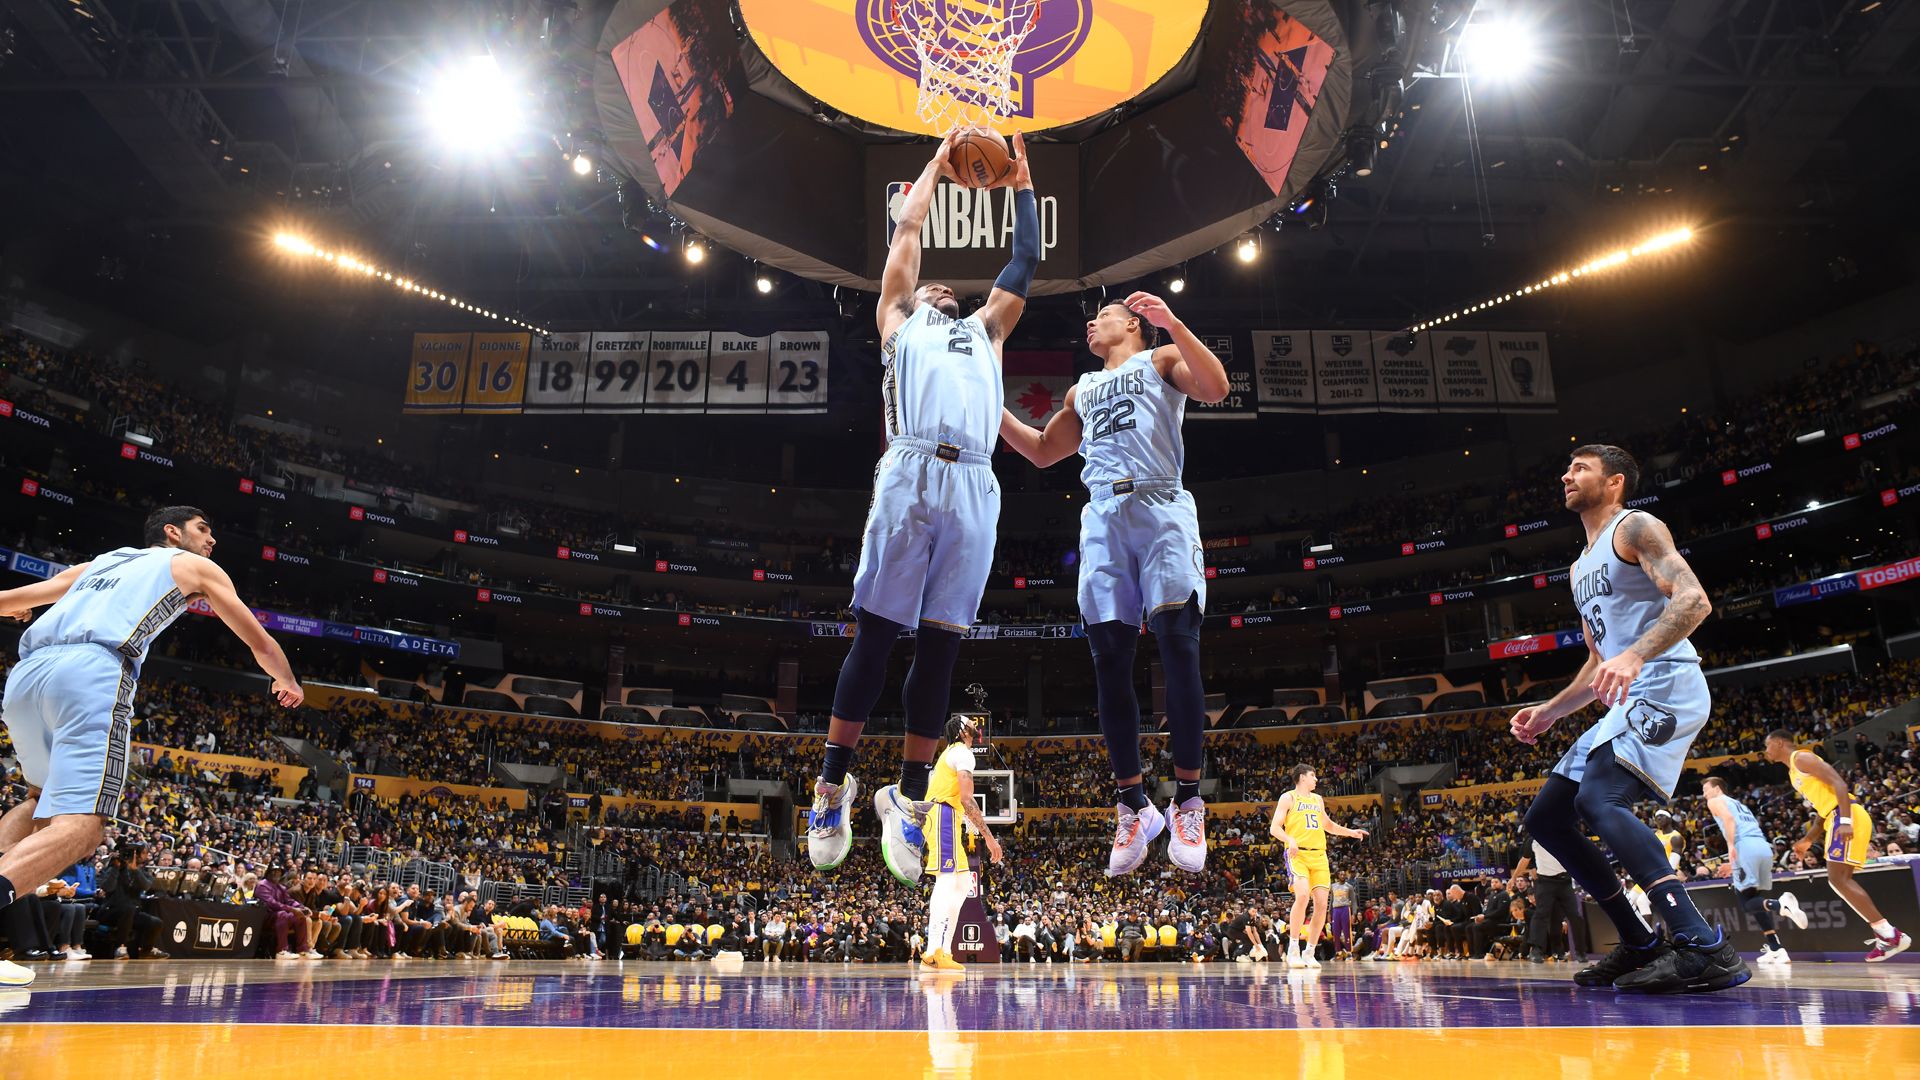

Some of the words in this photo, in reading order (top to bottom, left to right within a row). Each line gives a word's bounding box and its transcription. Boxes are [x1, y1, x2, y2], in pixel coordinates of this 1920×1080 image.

[922, 183, 996, 249] NBA
[1000, 186, 1058, 261] Ap
[421, 341, 463, 351] VACHON
[479, 341, 521, 351] DIONNE
[541, 341, 580, 351] TAYLOR
[596, 341, 645, 351] GRETZKY
[652, 340, 708, 350] ROBITAILLE
[722, 341, 758, 351] BLAKE
[780, 341, 821, 351] BROWN
[948, 328, 973, 356] 2
[1499, 341, 1540, 351] MILLER
[1325, 360, 1363, 368] WESTERN
[414, 361, 459, 392] 30
[478, 361, 512, 391] 16
[538, 361, 574, 391] 18
[595, 360, 641, 391] 99
[653, 360, 700, 391] 20
[726, 360, 750, 391] 4
[777, 360, 820, 392] 23
[1231, 371, 1250, 381] CUP
[1260, 369, 1309, 377] CONFERENCE
[1319, 369, 1370, 377] CONFERENCE
[1263, 378, 1308, 386] CHAMPIONS
[1322, 376, 1369, 386] CHAMPIONS
[1383, 377, 1429, 385] CHAMPIONS
[1442, 377, 1488, 385] CHAMPIONS
[1081, 368, 1145, 418] GRIZZLIES
[1270, 388, 1303, 397] 2013-14
[1330, 389, 1364, 398] 2011-12
[16, 409, 49, 427] TOYOTA
[1092, 399, 1137, 442] 22
[1862, 424, 1896, 440] TOYOTA
[140, 452, 173, 467] TOYOTA
[1738, 463, 1771, 477] TOYOTA
[41, 488, 73, 504] TOYOTA
[256, 486, 286, 500] TOYOTA
[1627, 496, 1659, 508] TOYOTA
[366, 513, 395, 525] TOYOTA
[1772, 517, 1808, 531] TOYOTA
[1519, 521, 1548, 531] TOYOTA
[470, 536, 498, 545] TOYOTA
[1416, 541, 1445, 550] TOYOTA
[278, 552, 309, 565] TOYOTA
[572, 551, 599, 560] TOYOTA
[21, 559, 46, 573] UCLA
[88, 552, 147, 576] 7
[1317, 557, 1345, 566] TOYOTA
[670, 564, 698, 572] TOYOTA
[1218, 567, 1247, 576] TOYOTA
[390, 574, 418, 586] TOYOTA
[767, 573, 793, 581] TOYOTA
[1027, 579, 1056, 587] TOYOTA
[1818, 579, 1856, 594] ULTRA
[493, 594, 521, 603] TOYOTA
[1444, 591, 1474, 601] TOYOTA
[594, 607, 621, 616] TOYOTA
[1343, 605, 1371, 614] TOYOTA
[693, 616, 720, 625] TOYOTA
[1244, 616, 1272, 624] TOYOTA
[1051, 627, 1066, 637] 13
[361, 631, 391, 645] ULTRA
[412, 640, 455, 655] DELTA
[358, 779, 372, 788] 114
[571, 799, 585, 807] 115
[1426, 794, 1439, 803] 117
[1305, 813, 1319, 828] 15
[1453, 868, 1497, 877] CHAMPIONS
[958, 943, 967, 951] GET
[967, 943, 976, 951] THE
[976, 943, 985, 951] APP
